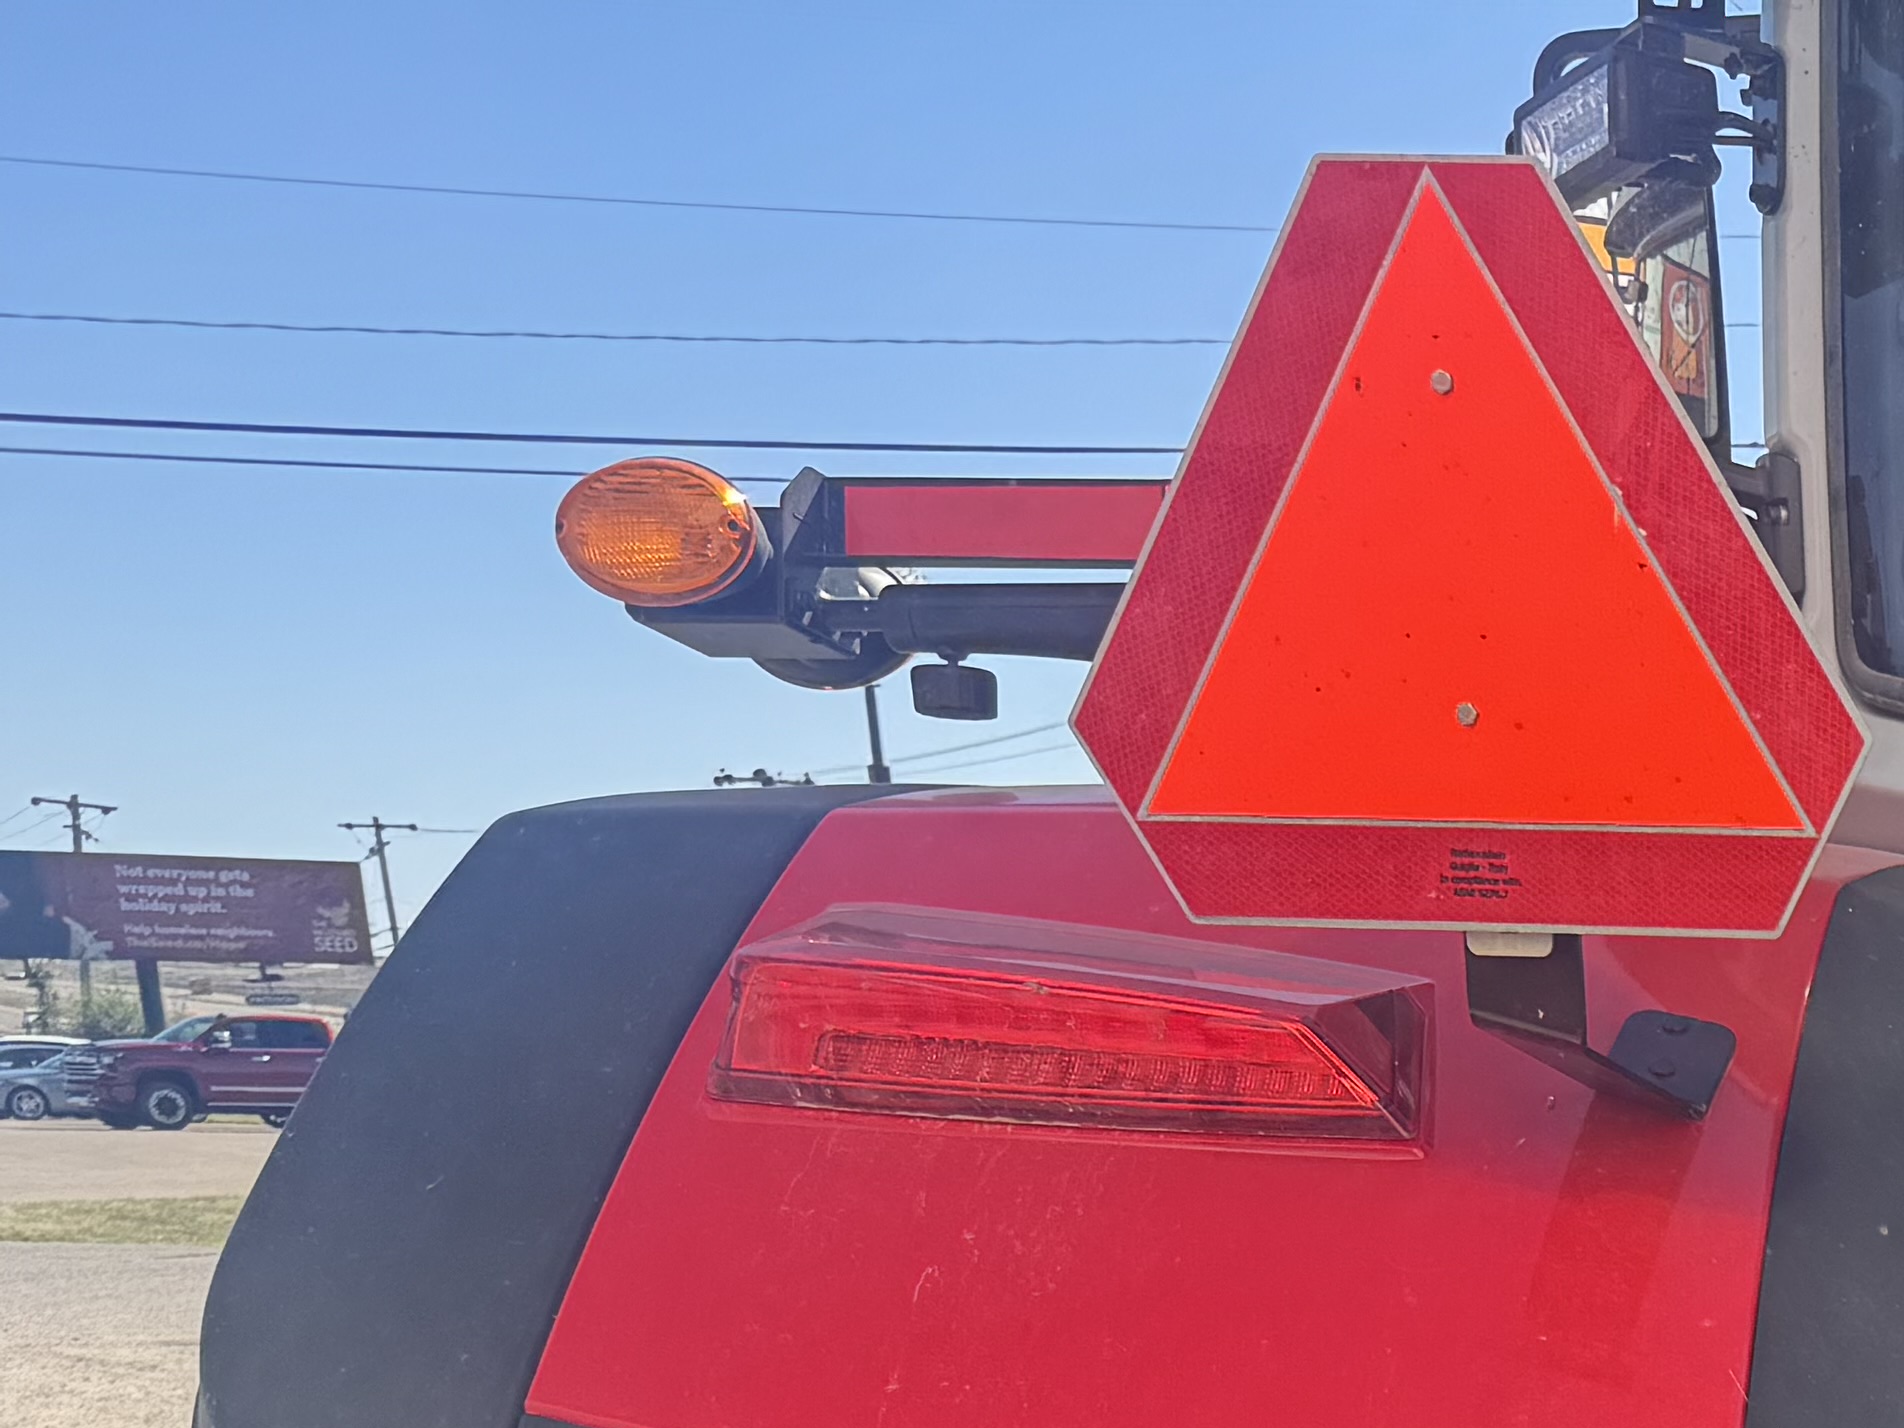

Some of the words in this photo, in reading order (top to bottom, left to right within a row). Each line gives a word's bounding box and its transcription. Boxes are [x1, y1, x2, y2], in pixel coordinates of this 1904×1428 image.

[114, 864, 143, 878] Not
[147, 868, 216, 881] everyone
[117, 882, 185, 898] wrapped
[187, 885, 208, 898] up
[210, 884, 226, 897] in
[229, 885, 255, 897] the
[119, 898, 177, 915] holiday
[314, 936, 358, 953] SEED
